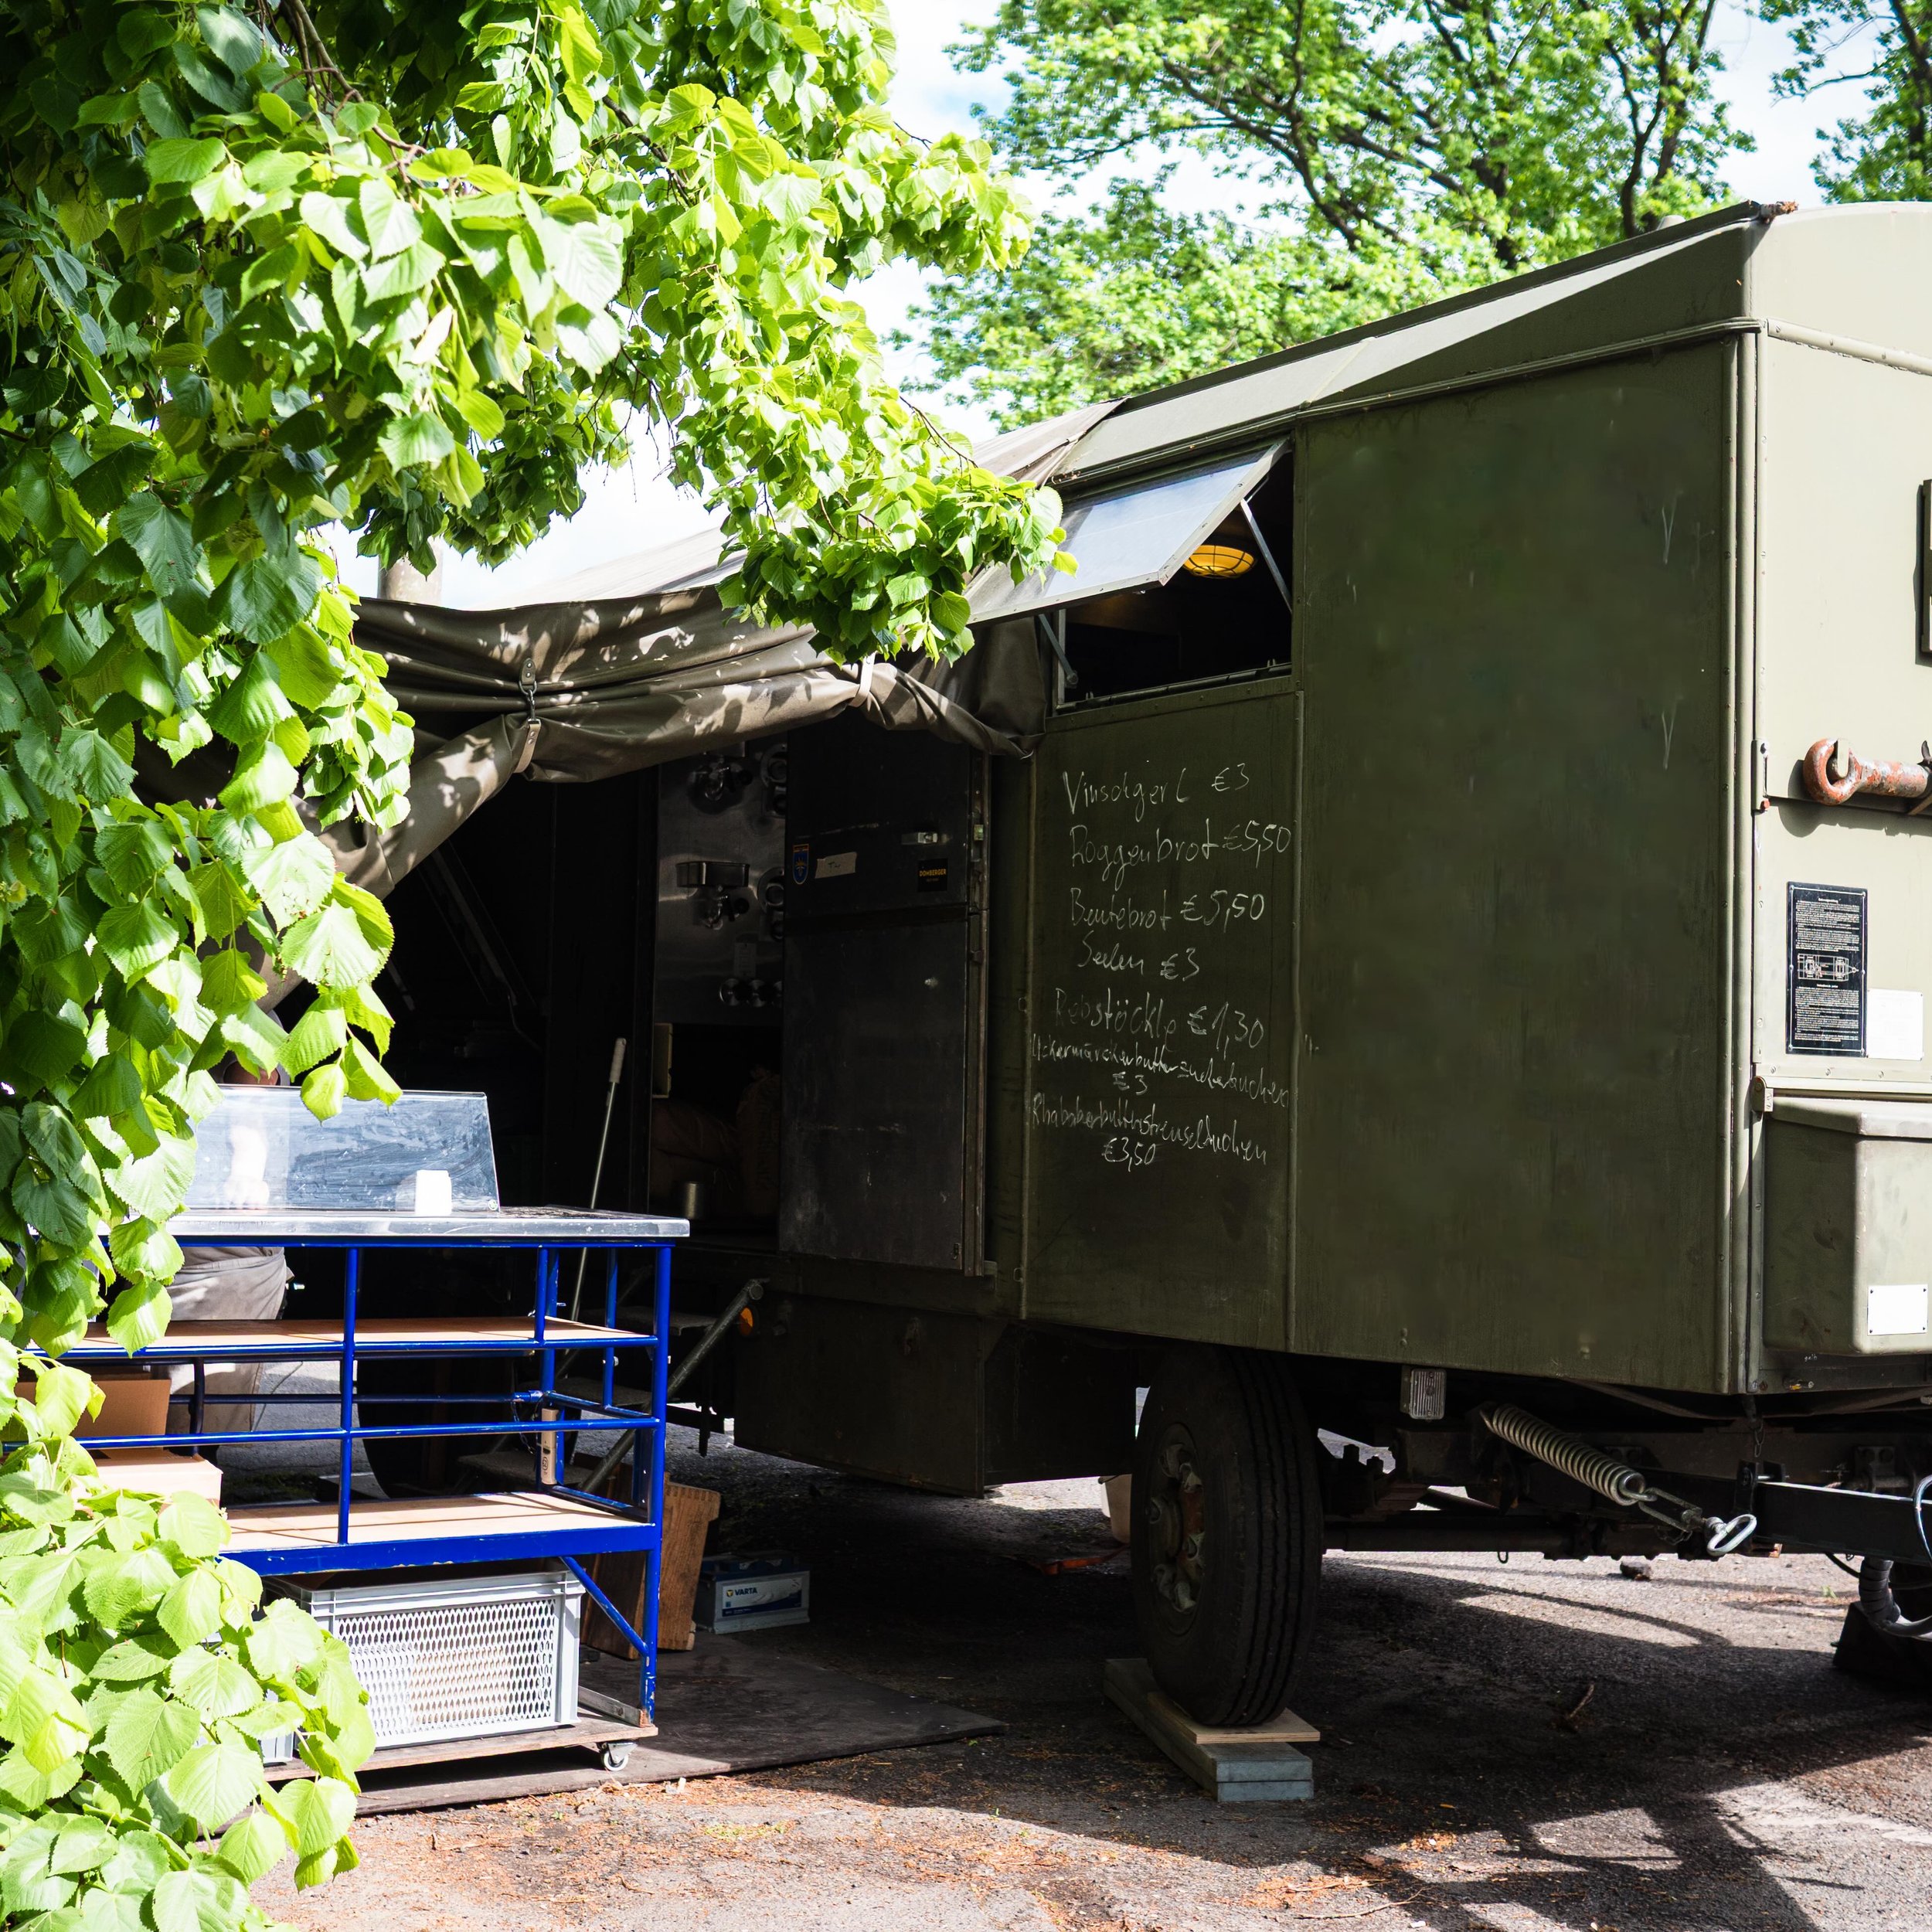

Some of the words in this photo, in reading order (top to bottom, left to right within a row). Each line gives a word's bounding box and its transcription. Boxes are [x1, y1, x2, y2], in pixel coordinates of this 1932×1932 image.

[1069, 818, 1219, 892] Roggenbrot
[1222, 820, 1292, 869] €5,50
[1180, 890, 1265, 933] €5,50
[1077, 930, 1144, 975] Seelen
[1187, 1002, 1264, 1062] €1,30
[1101, 1137, 1157, 1172] €3,50
[734, 1587, 757, 1596] VARTA
